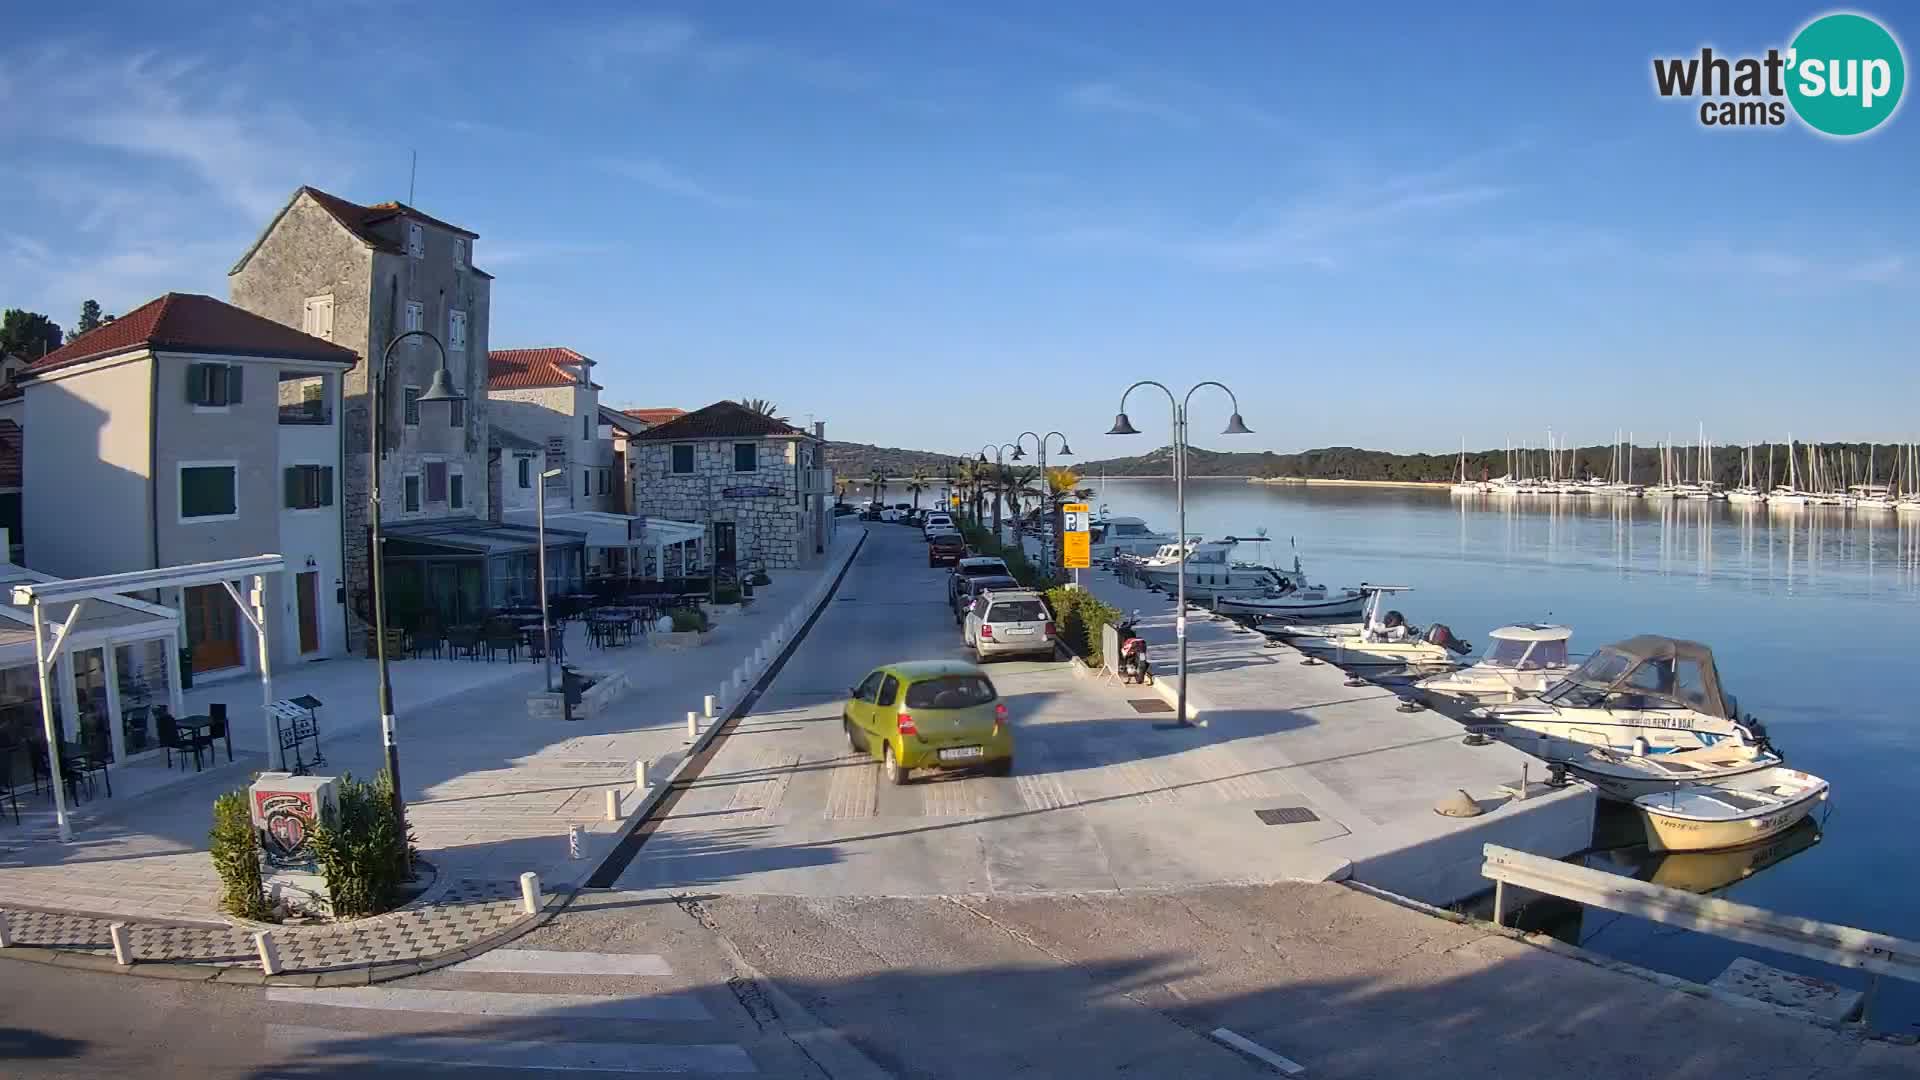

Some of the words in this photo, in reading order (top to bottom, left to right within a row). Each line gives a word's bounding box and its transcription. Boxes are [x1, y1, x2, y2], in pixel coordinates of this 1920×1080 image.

[1065, 513, 1076, 530] P
[1652, 718, 1671, 728] RENT
[1678, 718, 1695, 729] BOAT
